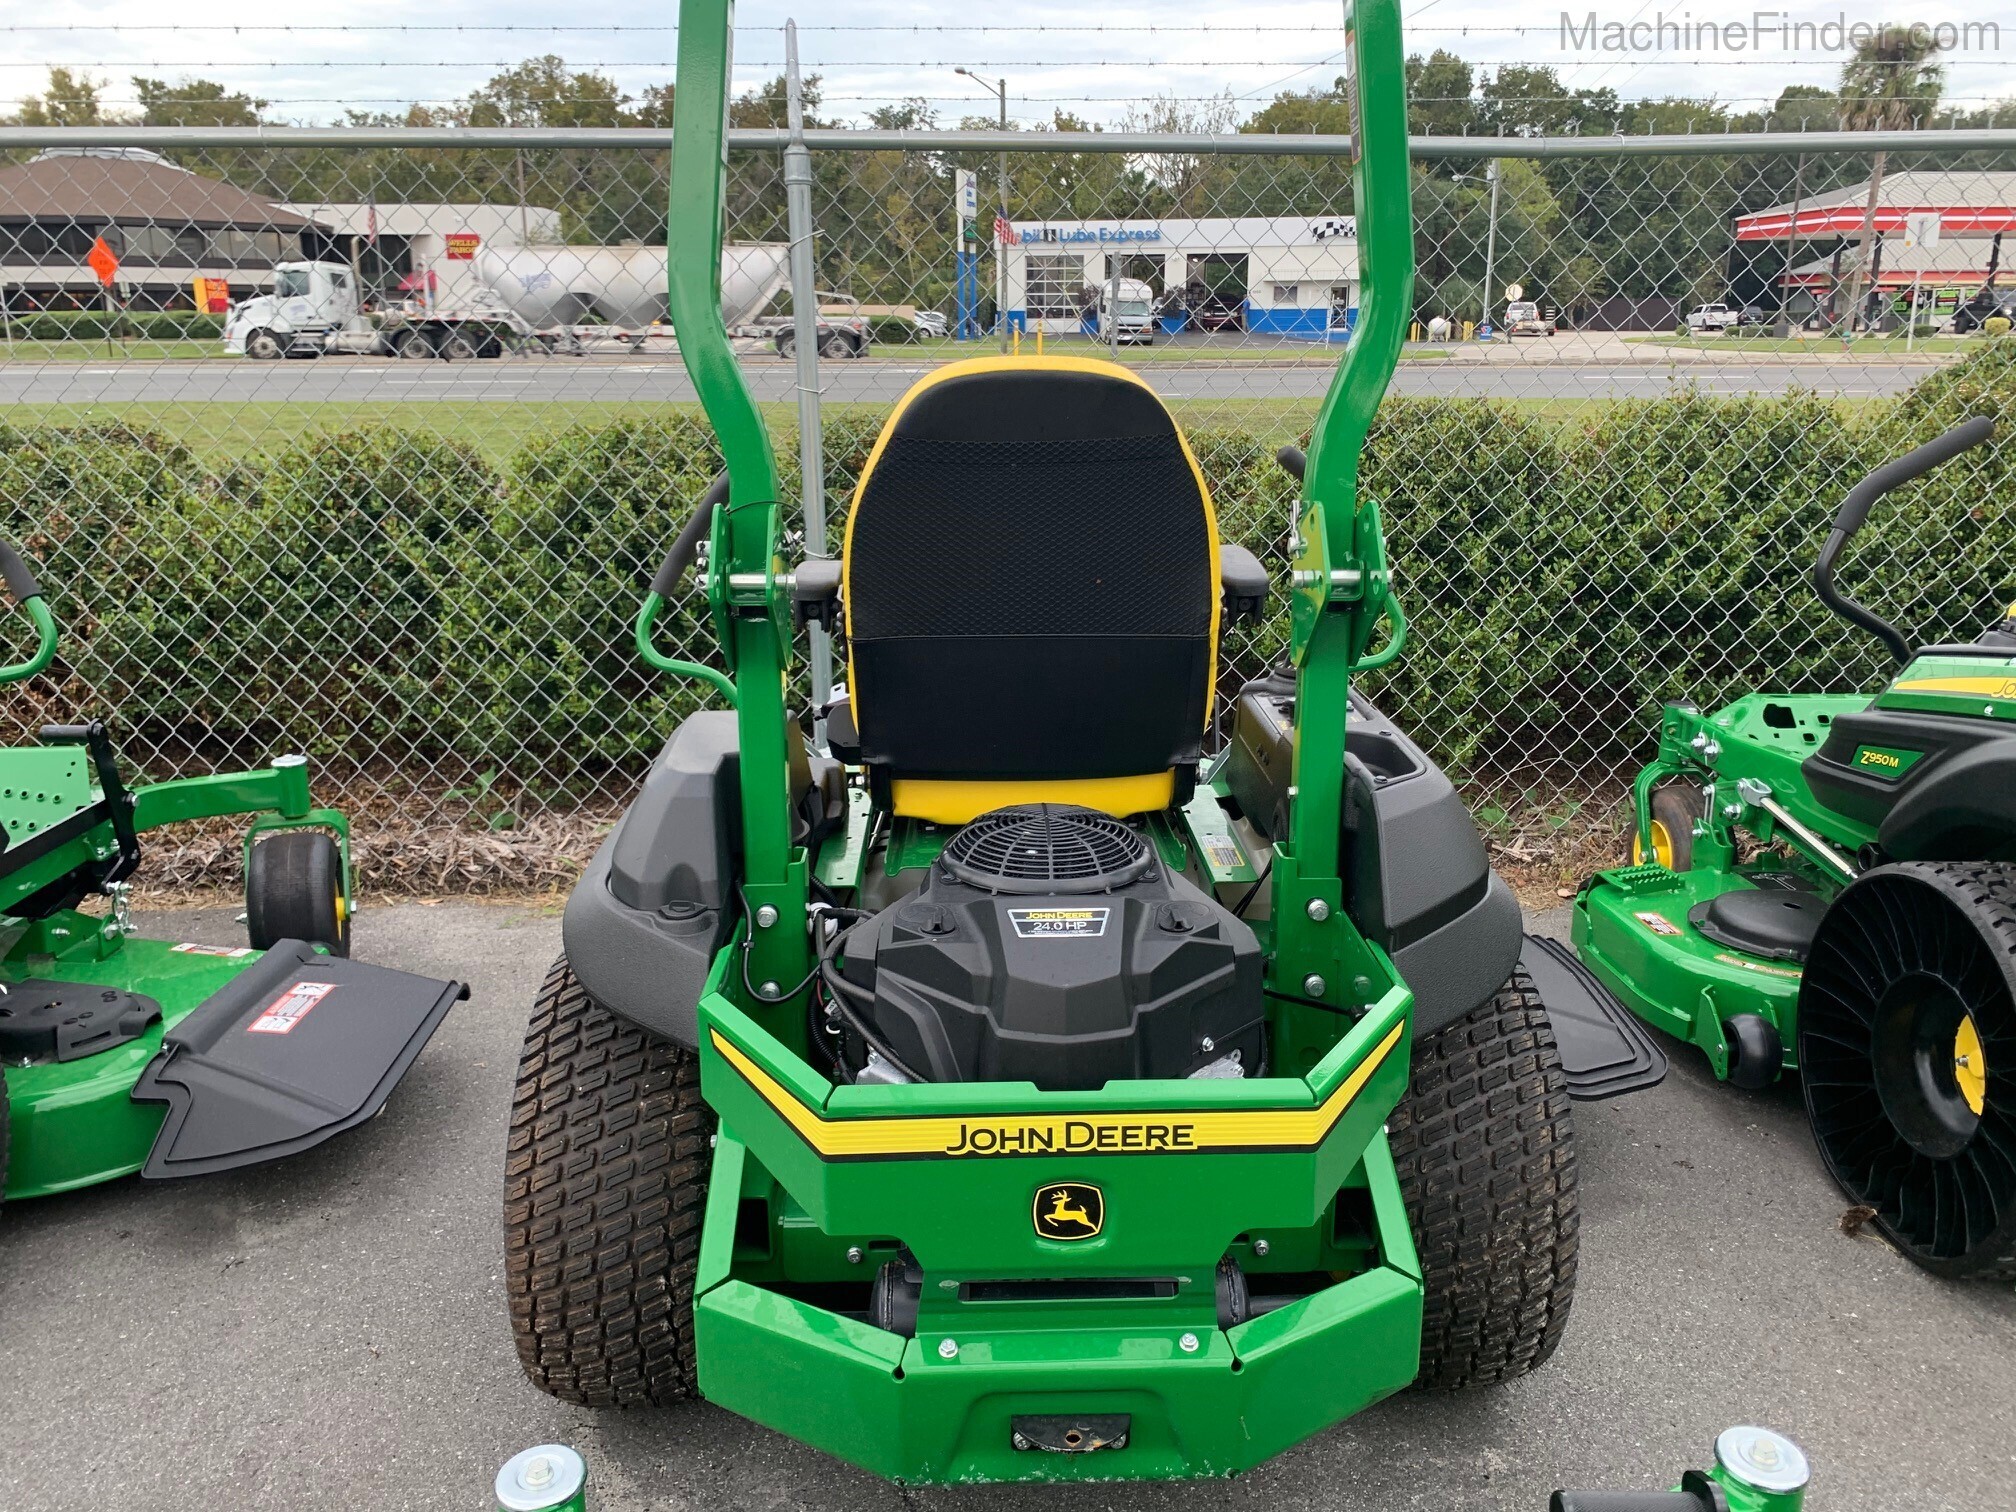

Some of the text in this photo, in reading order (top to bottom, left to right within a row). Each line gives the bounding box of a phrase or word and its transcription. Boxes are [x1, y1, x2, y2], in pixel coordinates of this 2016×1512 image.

[1059, 228, 1096, 243] Lube
[1099, 227, 1162, 244] Express
[1992, 679, 2016, 696] JO
[1860, 751, 1899, 768] Z950M
[1033, 921, 1087, 931] 24.0 HP
[946, 1121, 1195, 1151] JOHN DEERE
